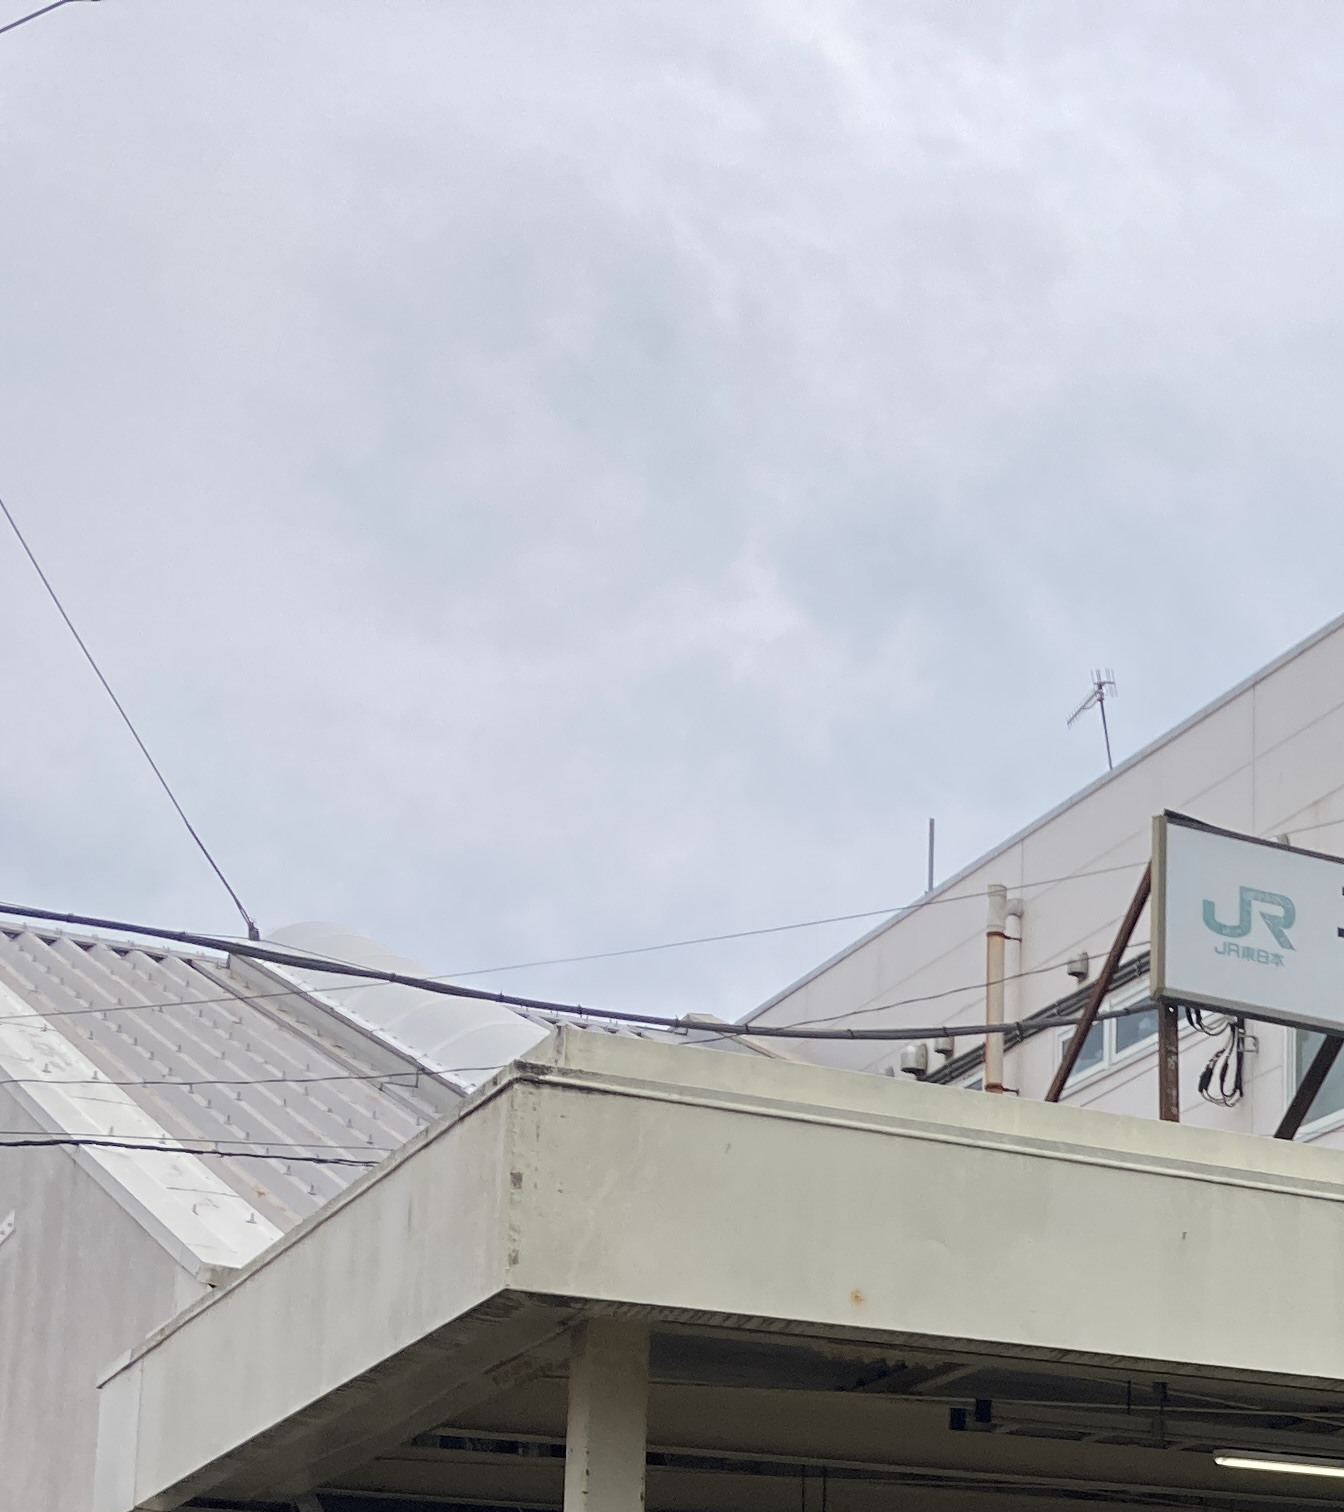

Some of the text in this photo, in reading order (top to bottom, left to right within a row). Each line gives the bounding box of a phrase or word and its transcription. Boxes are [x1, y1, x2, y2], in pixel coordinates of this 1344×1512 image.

[1203, 886, 1296, 951] JR
[1214, 941, 1285, 968] JR東日本
